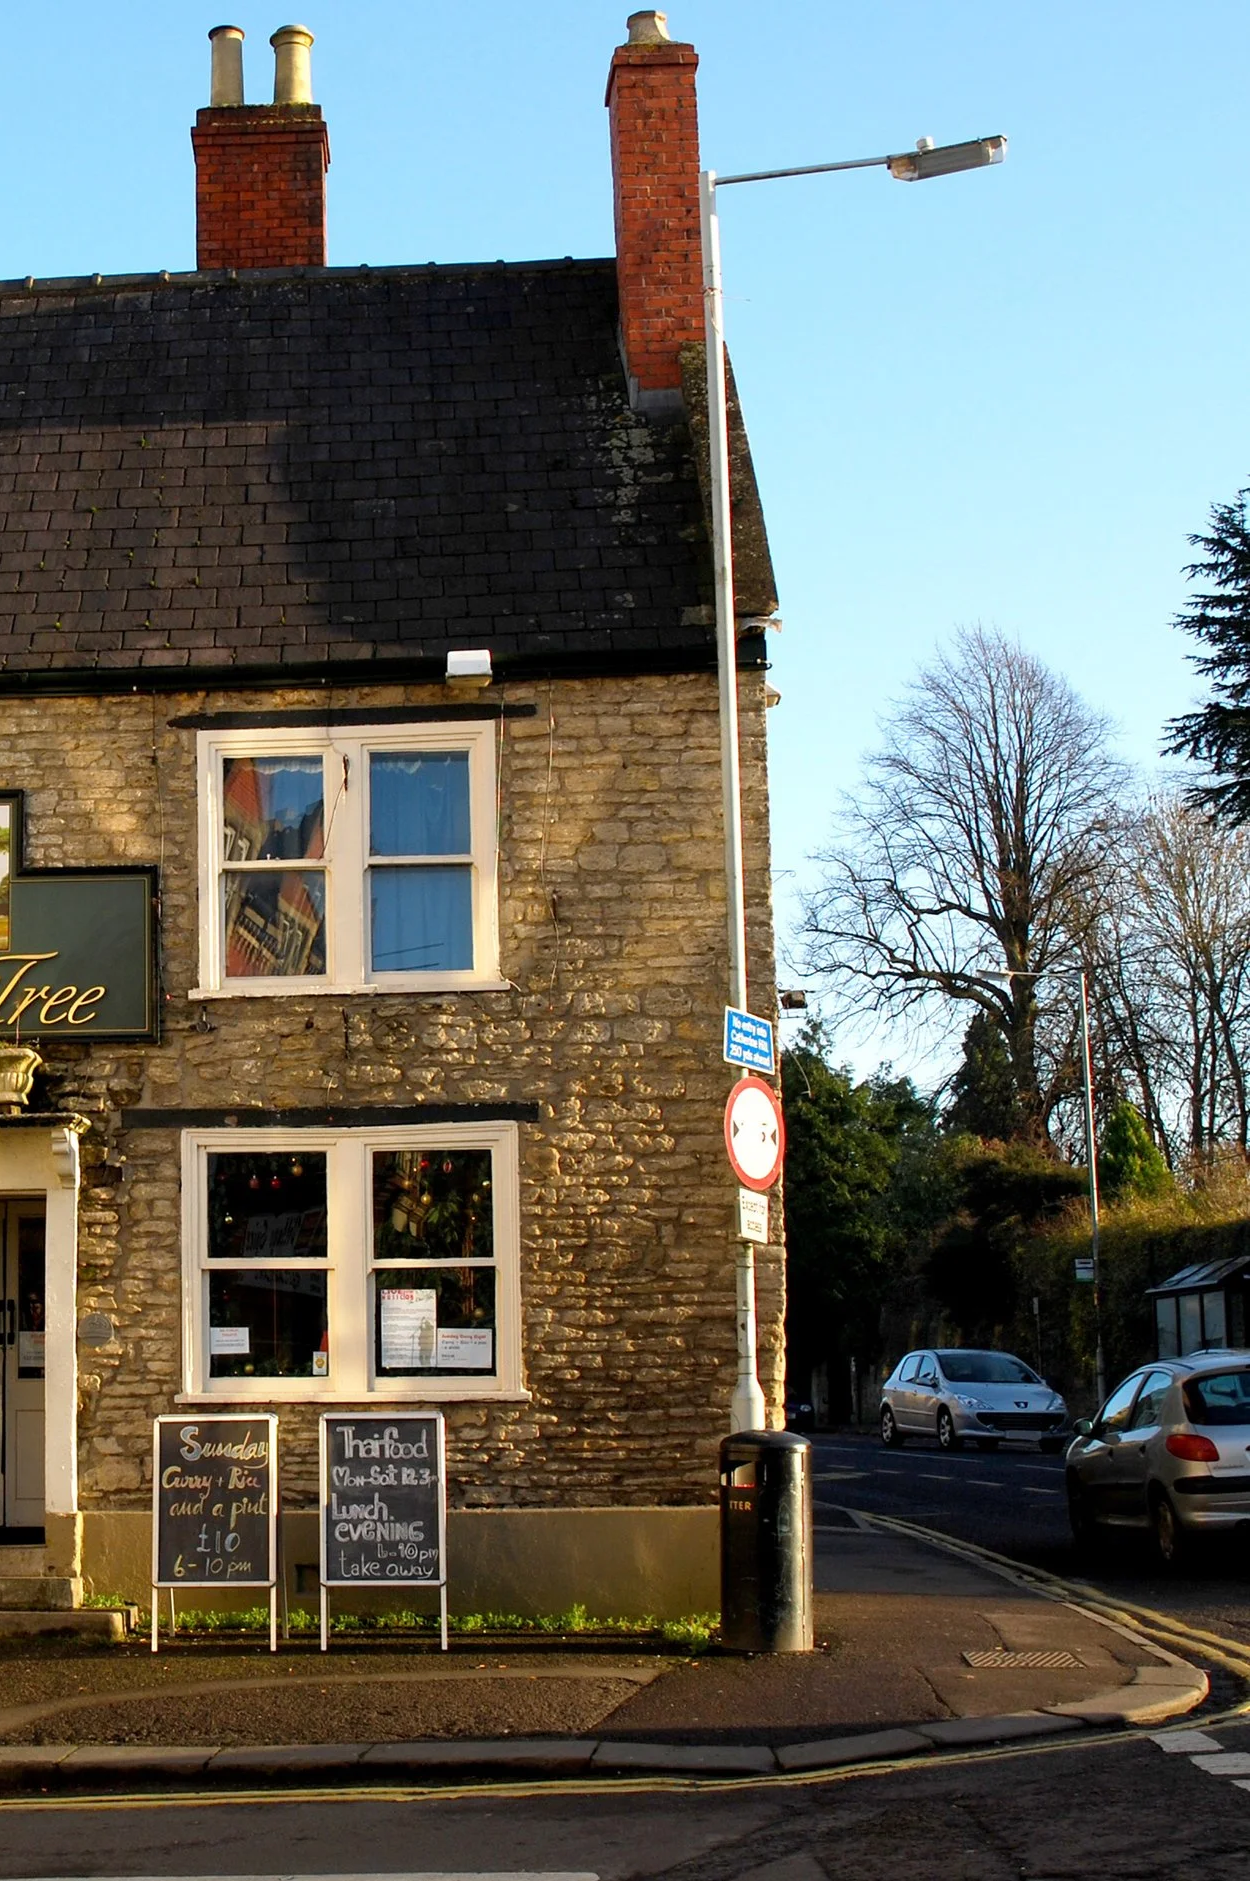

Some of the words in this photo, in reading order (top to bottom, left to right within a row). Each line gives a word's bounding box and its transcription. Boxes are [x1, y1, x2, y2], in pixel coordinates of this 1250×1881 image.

[180, 1425, 269, 1469] Sunday
[161, 1465, 213, 1499] Curry
[227, 1465, 261, 1489] Rice
[169, 1499, 205, 1517] and
[211, 1503, 225, 1517] a
[230, 1493, 267, 1530] pint
[196, 1523, 240, 1553] £10
[338, 1549, 381, 1578] take
[386, 1563, 434, 1580] away
